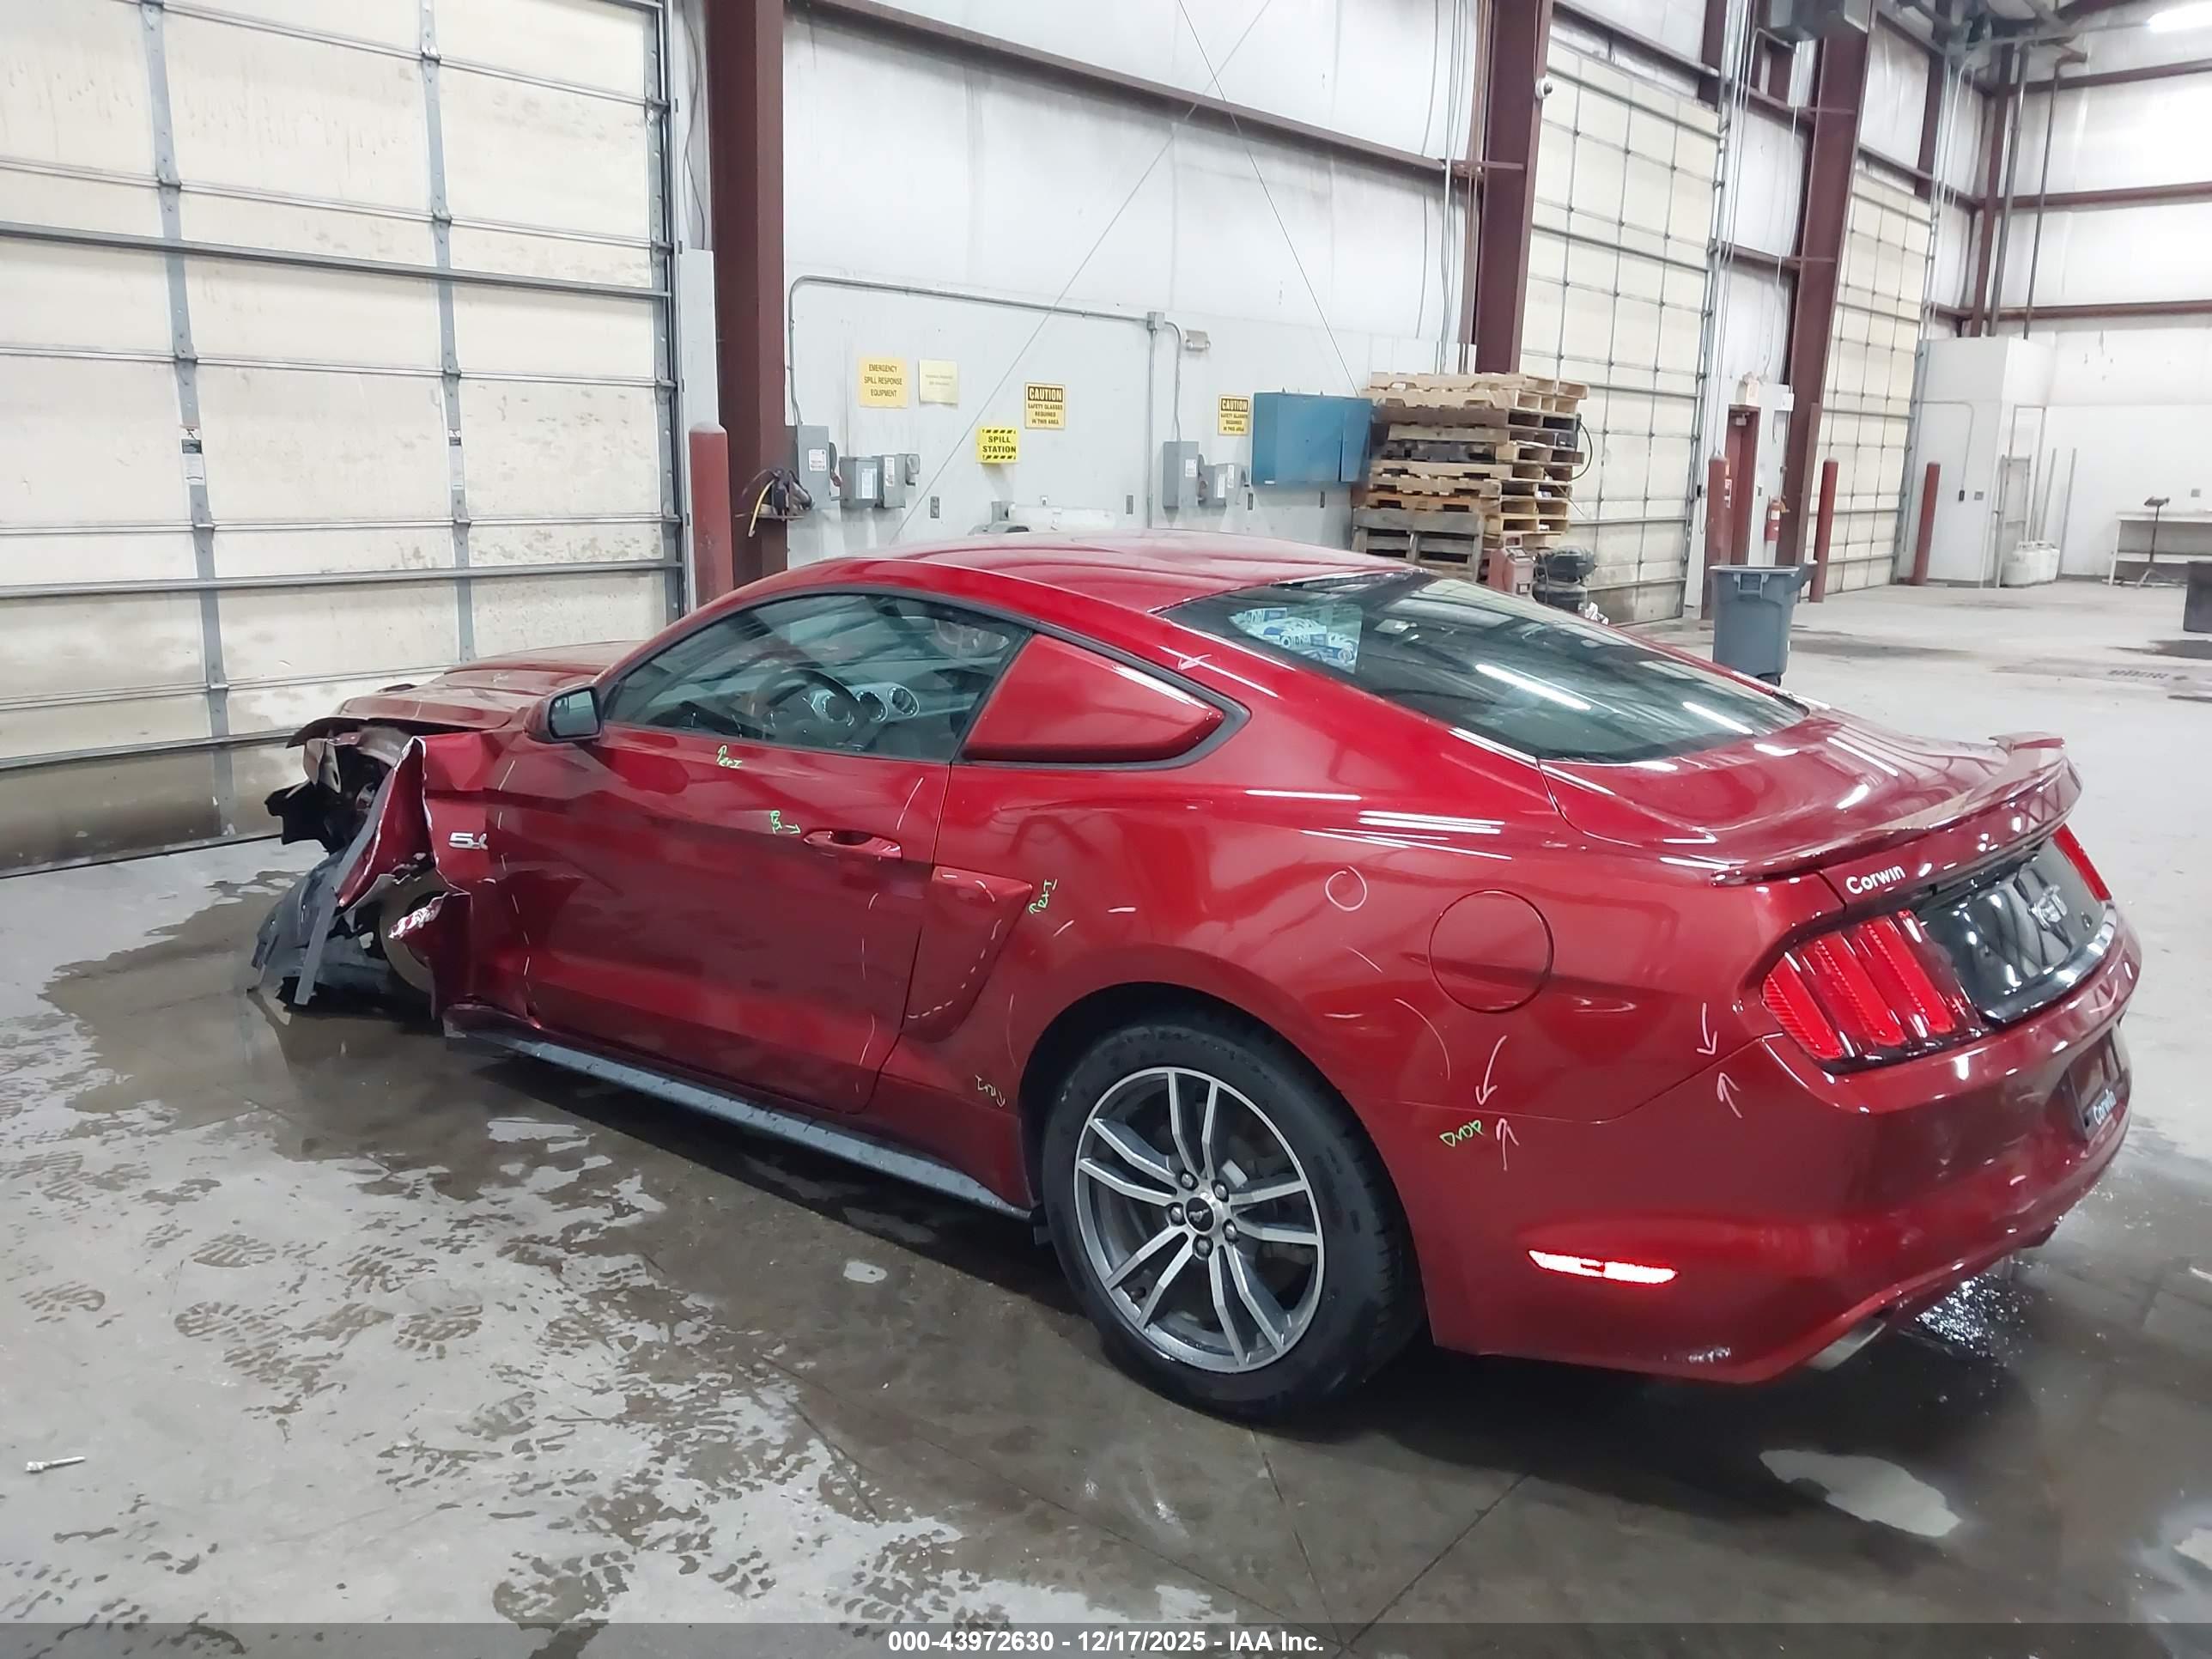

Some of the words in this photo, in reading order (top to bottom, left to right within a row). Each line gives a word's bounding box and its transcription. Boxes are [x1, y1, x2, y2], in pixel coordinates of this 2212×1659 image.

[868, 363, 897, 373] EMERGENCY
[878, 376, 902, 386] RESPONSE
[1029, 387, 1062, 401] CAUTION
[1222, 399, 1248, 411] CAUTION
[982, 445, 1017, 453] STATION
[1845, 865, 1906, 895] Corwin
